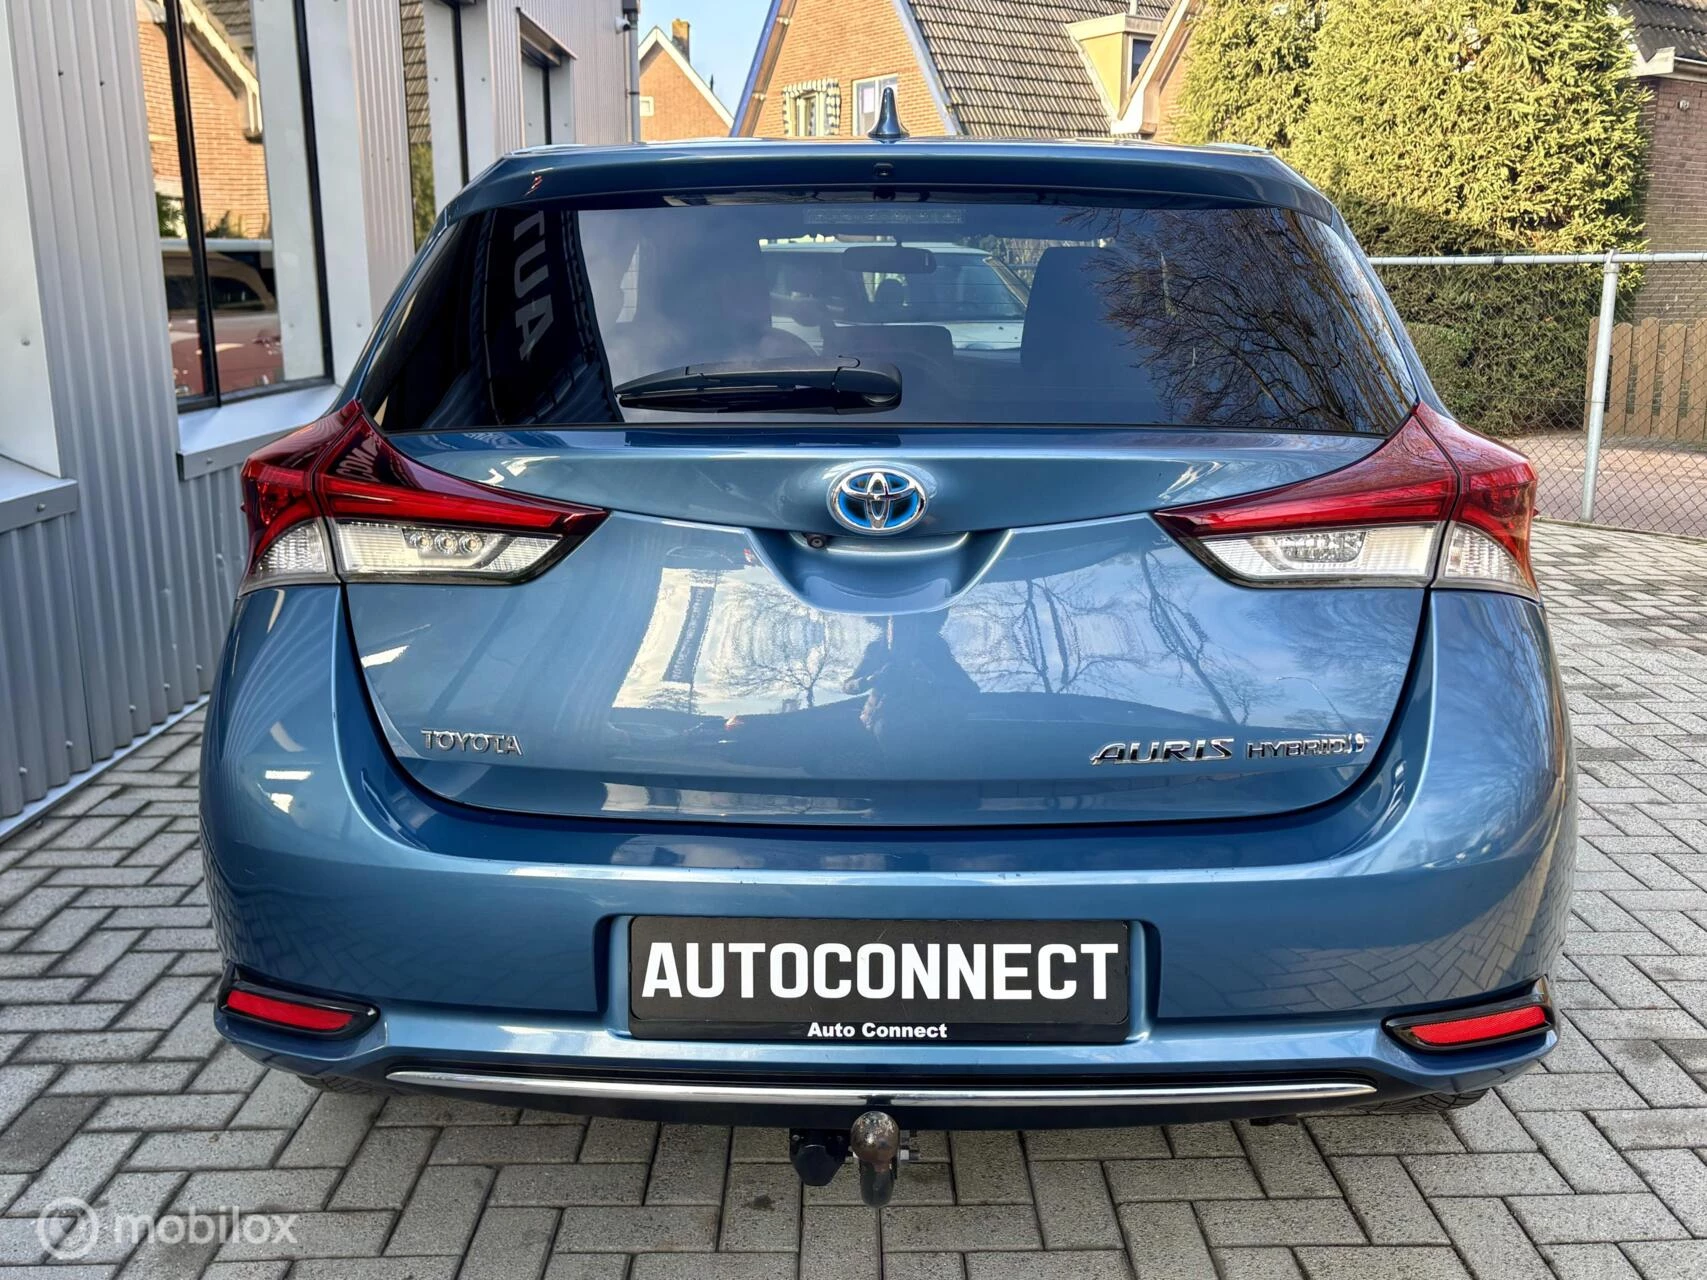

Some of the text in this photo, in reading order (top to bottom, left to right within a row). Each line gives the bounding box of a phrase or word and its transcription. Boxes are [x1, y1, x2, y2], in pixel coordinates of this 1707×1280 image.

[420, 730, 523, 756] TOYOTA
[1090, 738, 1347, 766] AURIS HYBRID
[641, 942, 1119, 1000] AUTOCONNECT
[807, 1022, 948, 1038] Auto Connect
